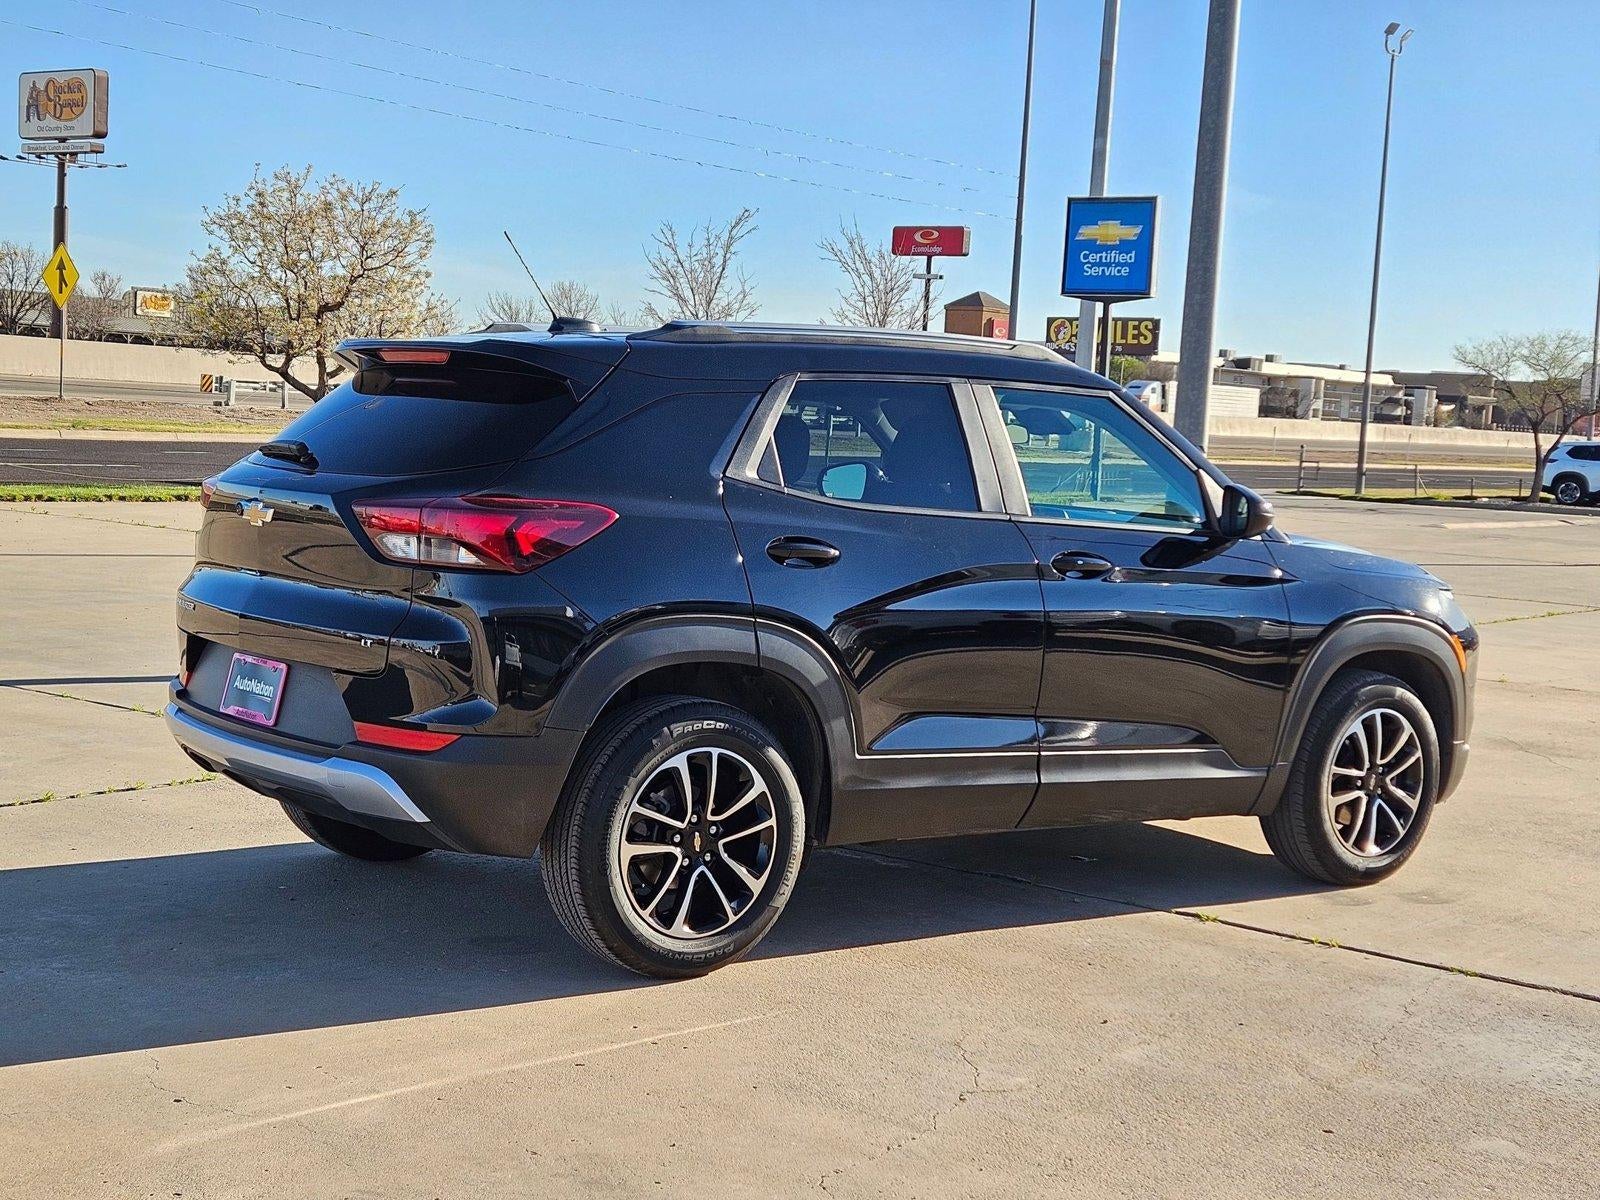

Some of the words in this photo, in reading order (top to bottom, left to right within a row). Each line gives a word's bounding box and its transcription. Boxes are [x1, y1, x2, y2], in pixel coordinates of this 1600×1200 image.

[45, 125, 62, 133] Country
[1080, 251, 1136, 263] Certified
[1083, 264, 1130, 276] Service
[361, 638, 373, 648] LT
[233, 674, 274, 697] AutoNation
